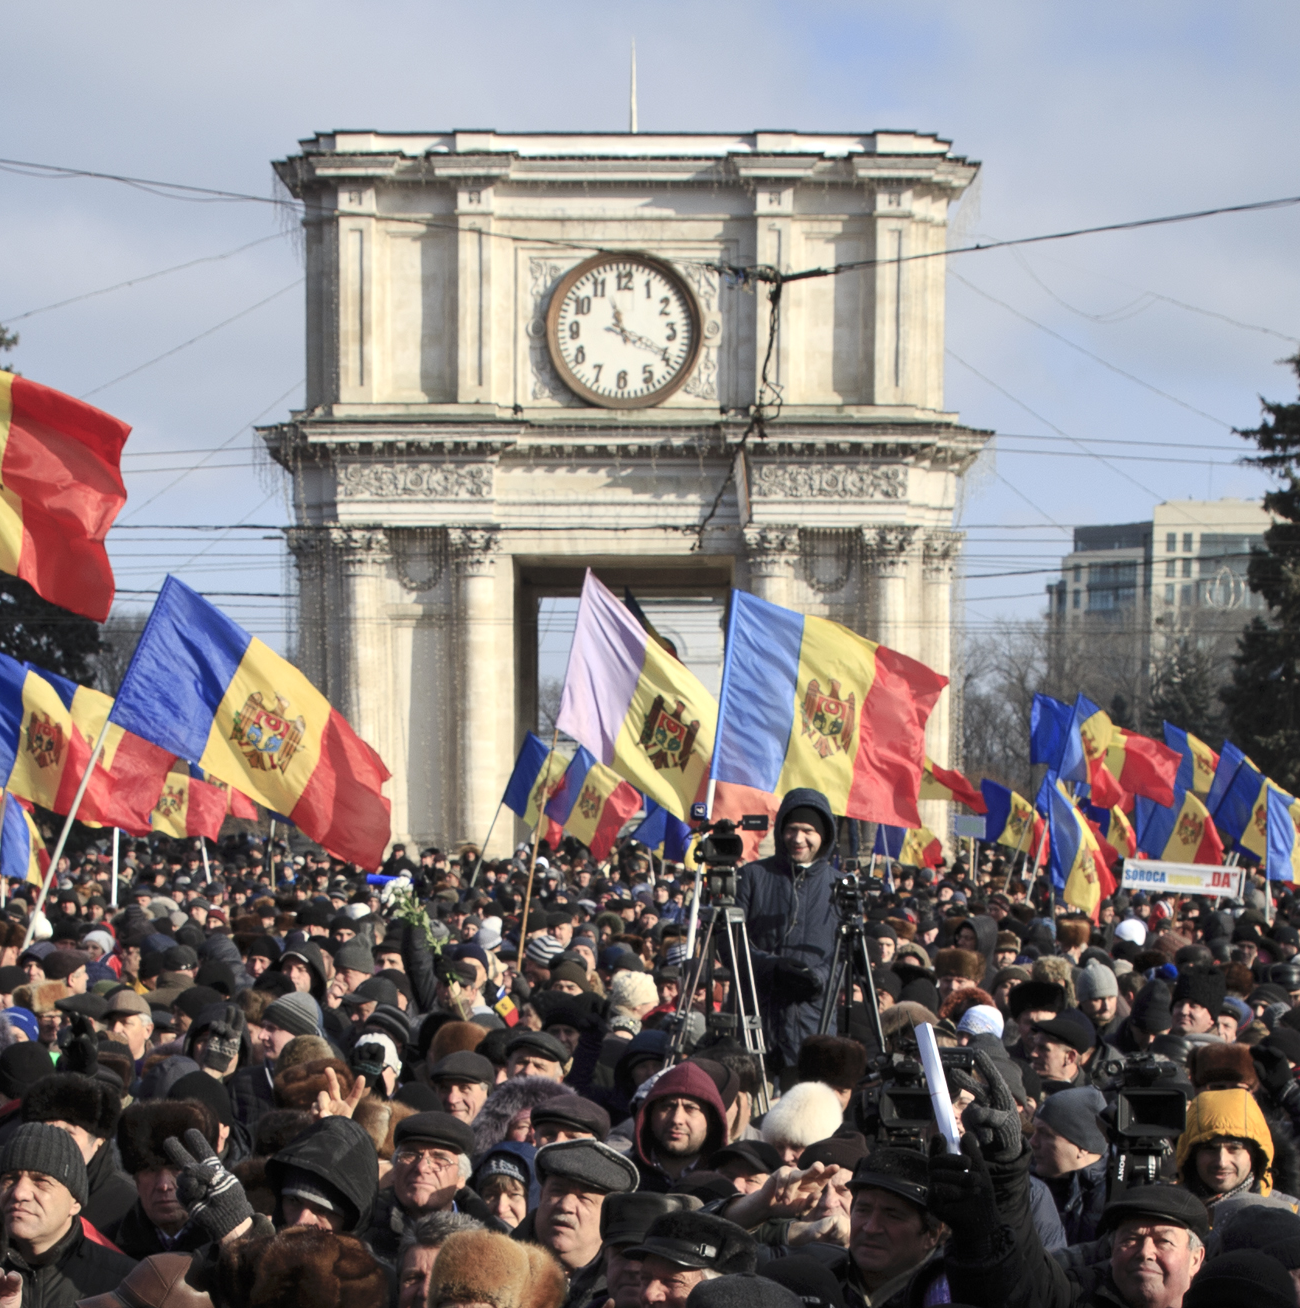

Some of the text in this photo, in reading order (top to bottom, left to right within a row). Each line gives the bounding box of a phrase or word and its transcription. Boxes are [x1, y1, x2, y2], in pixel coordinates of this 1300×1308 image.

[593, 277, 606, 298] 11
[616, 271, 634, 291] 12
[644, 279, 652, 299] 1
[574, 296, 591, 315] 10
[659, 296, 671, 315] 2
[569, 320, 580, 340] 9
[666, 322, 677, 341] 3
[574, 345, 586, 365] 8
[593, 364, 604, 383] 7
[616, 369, 628, 389] 6
[642, 364, 654, 384] 5
[1125, 869, 1166, 883] SOROCA
[1117, 1154, 1126, 1182] SONY
